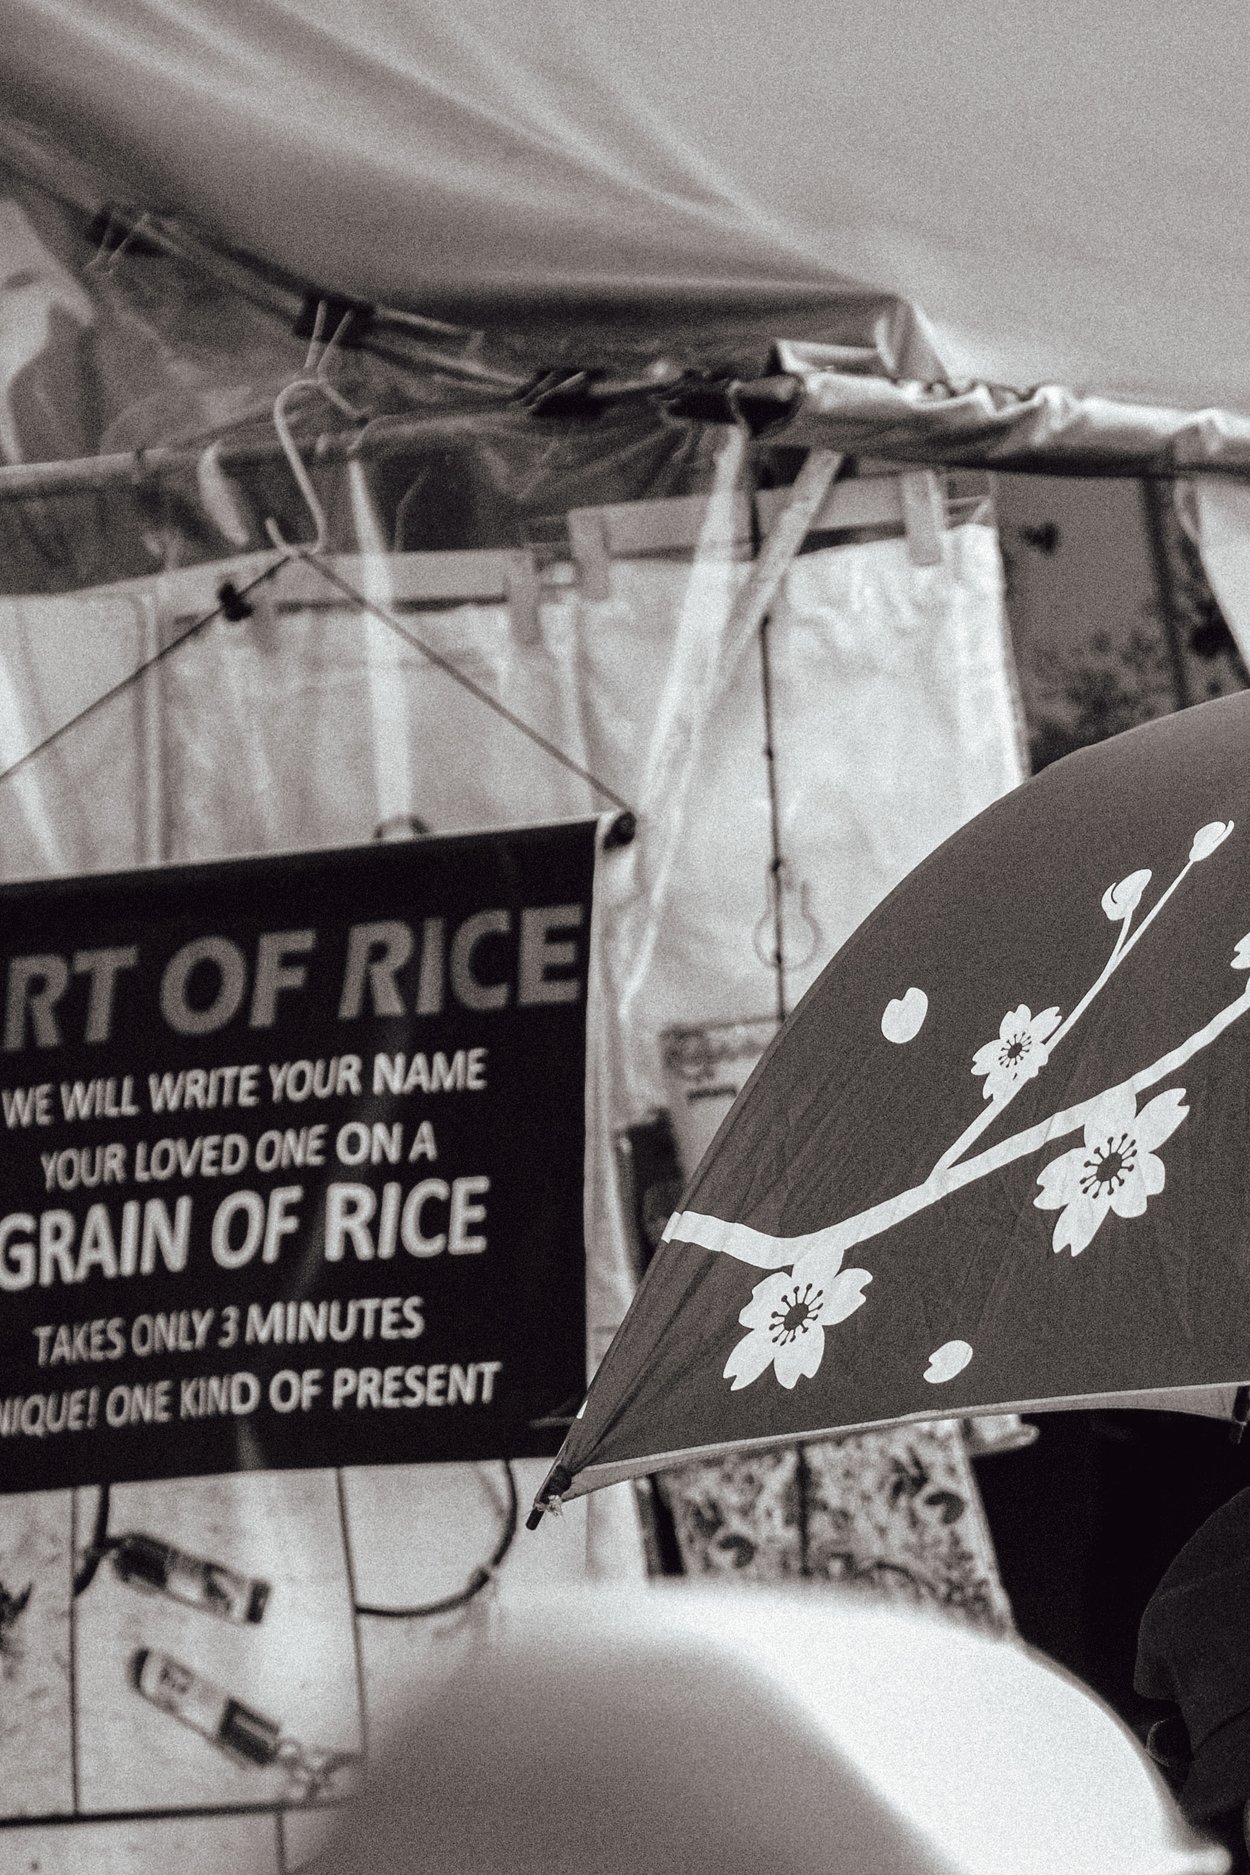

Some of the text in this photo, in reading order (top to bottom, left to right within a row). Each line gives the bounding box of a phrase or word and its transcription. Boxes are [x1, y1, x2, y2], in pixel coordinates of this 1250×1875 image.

[160, 929, 316, 1035] OF
[338, 903, 584, 1019] RICE
[1, 1048, 488, 1129] WE WILL WRITE YOUR NAME
[41, 1120, 438, 1191] YOUR LOVED ONE ON A
[0, 1176, 490, 1292] GRAIN OF RICE
[33, 1295, 425, 1367] TAKES ONLY 3 MINUTES
[106, 1380, 173, 1428] ONE
[180, 1371, 261, 1420] KIND
[268, 1369, 323, 1413] OF
[332, 1361, 503, 1410] PRESENT
